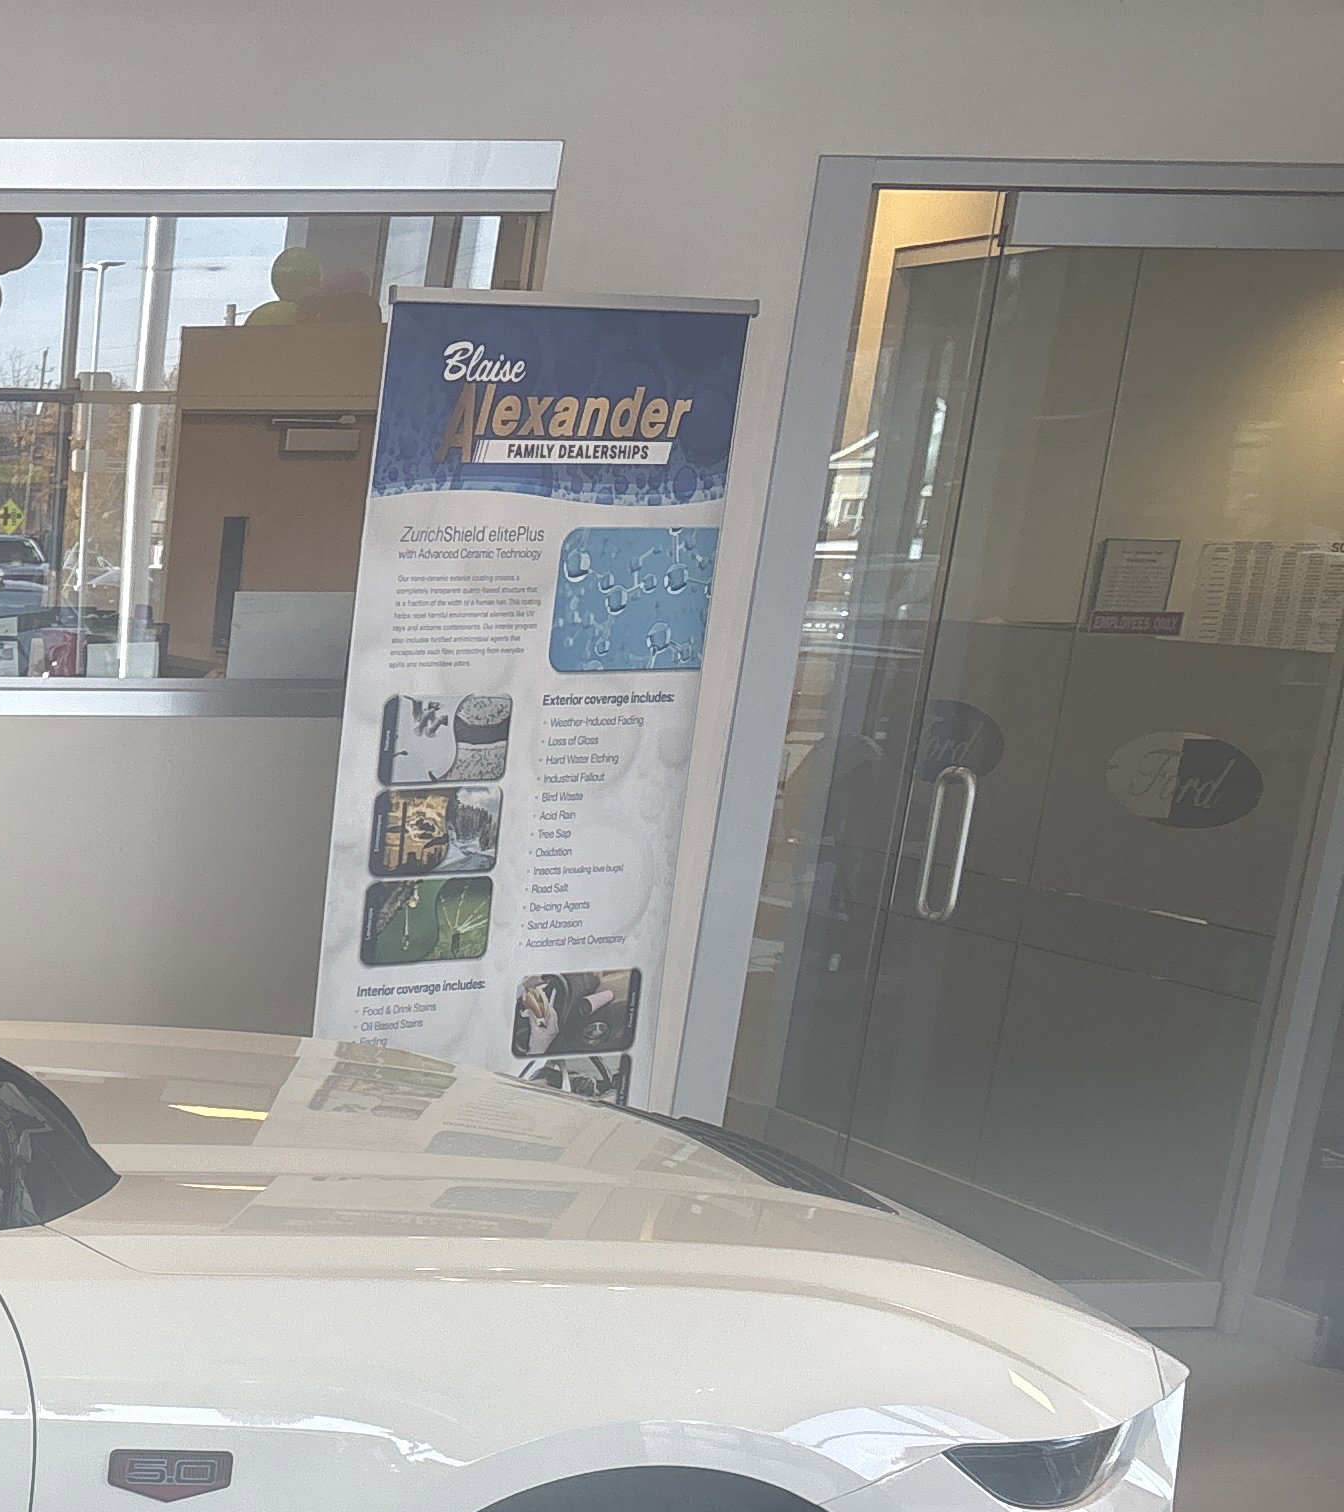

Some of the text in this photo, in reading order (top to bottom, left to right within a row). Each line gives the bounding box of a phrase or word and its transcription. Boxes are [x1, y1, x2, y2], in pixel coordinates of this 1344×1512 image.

[443, 341, 528, 384] Blaise
[435, 382, 694, 465] Alexander
[506, 443, 650, 461] FAMILY DEALERSHIPS
[488, 525, 545, 544] elitePlus
[398, 547, 542, 562] with Advanced Ceramic Technology
[1094, 615, 1179, 631] EMPLOYEES ONLY
[542, 691, 675, 707] Exterior coverage includes:
[547, 736, 567, 746] Loss
[545, 755, 566, 765] Hard
[539, 810, 558, 821] Acid
[555, 828, 572, 840] Sap
[527, 920, 549, 931] Sand
[357, 978, 486, 998] Interior coverage includes:
[362, 1005, 384, 1017] Food
[360, 1021, 373, 1032] Oil
[374, 1020, 399, 1031] Based
[125, 1458, 217, 1485] 5.0
